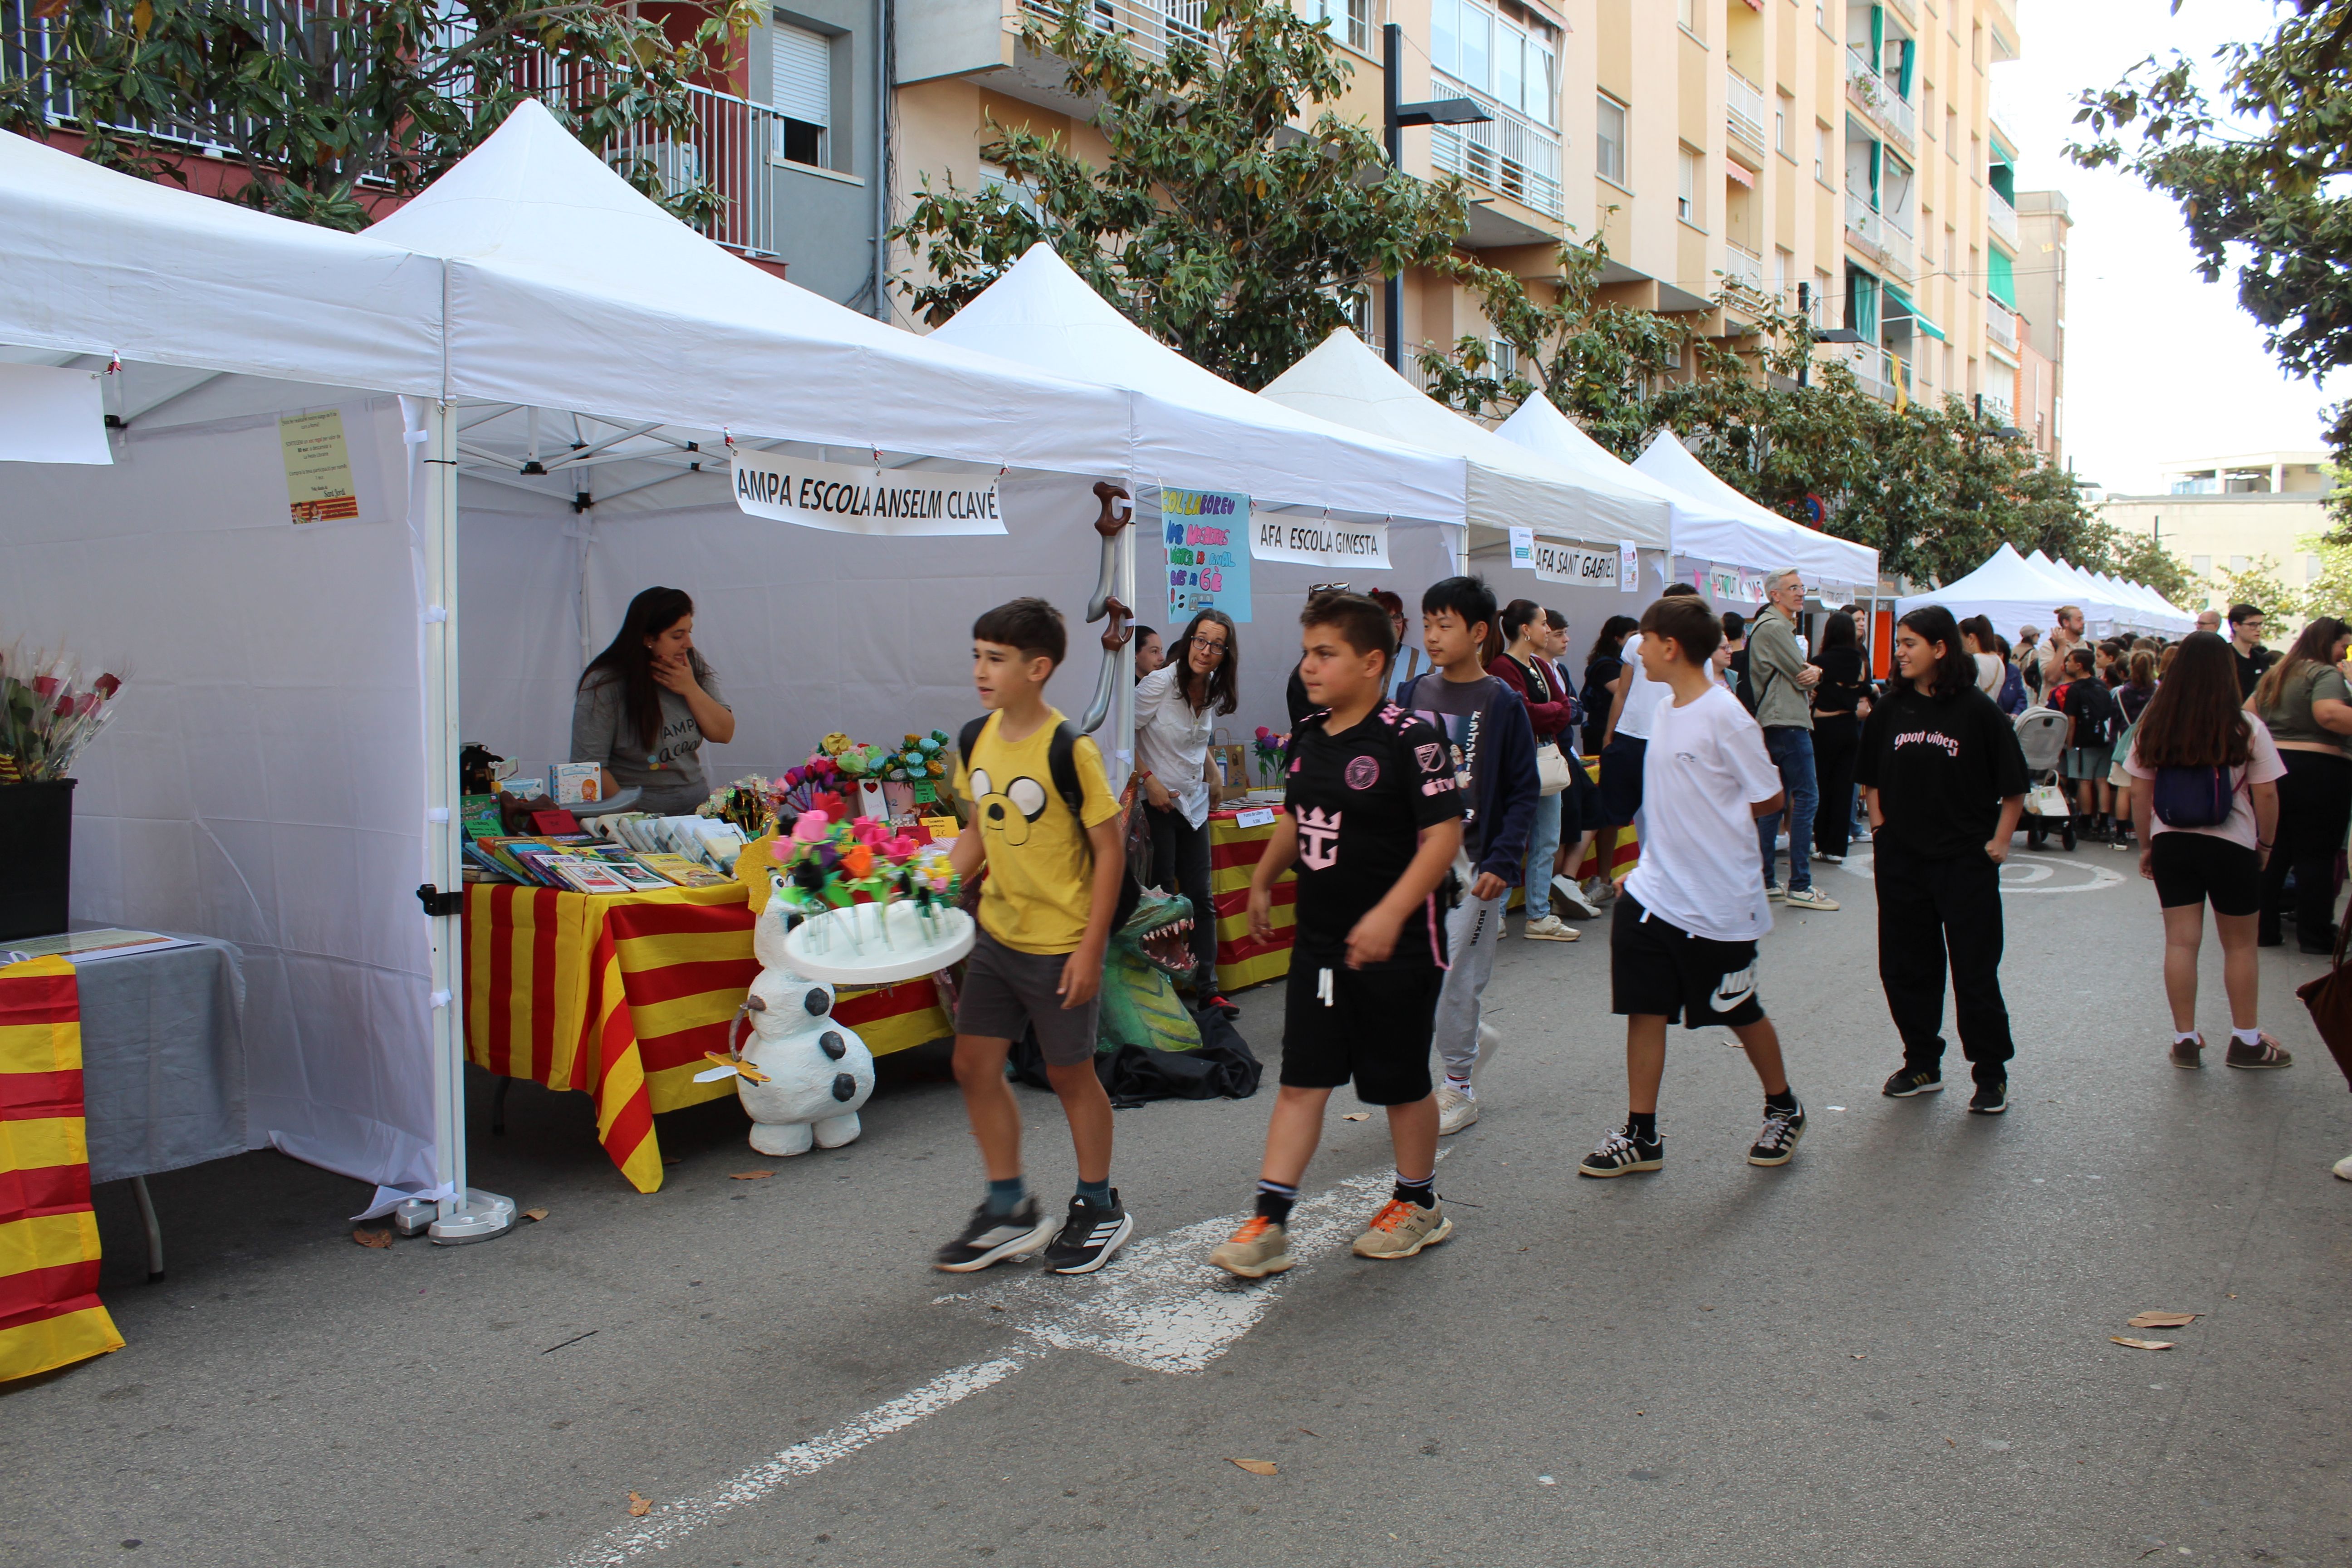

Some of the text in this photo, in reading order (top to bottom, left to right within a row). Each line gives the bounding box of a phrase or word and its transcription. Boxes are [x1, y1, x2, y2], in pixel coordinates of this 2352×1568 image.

[323, 488, 346, 498] Sant Jordi
[738, 468, 999, 519] AMPA ESCOLA ANSELM CLAVÉ
[1260, 524, 1379, 556] AFA ESCOLA GINESTA
[1536, 548, 1615, 579] AFA SANT GABRIEL
[663, 718, 695, 740] AMP
[1895, 730, 1959, 756] good vibes
[1719, 966, 1755, 995] NIK
